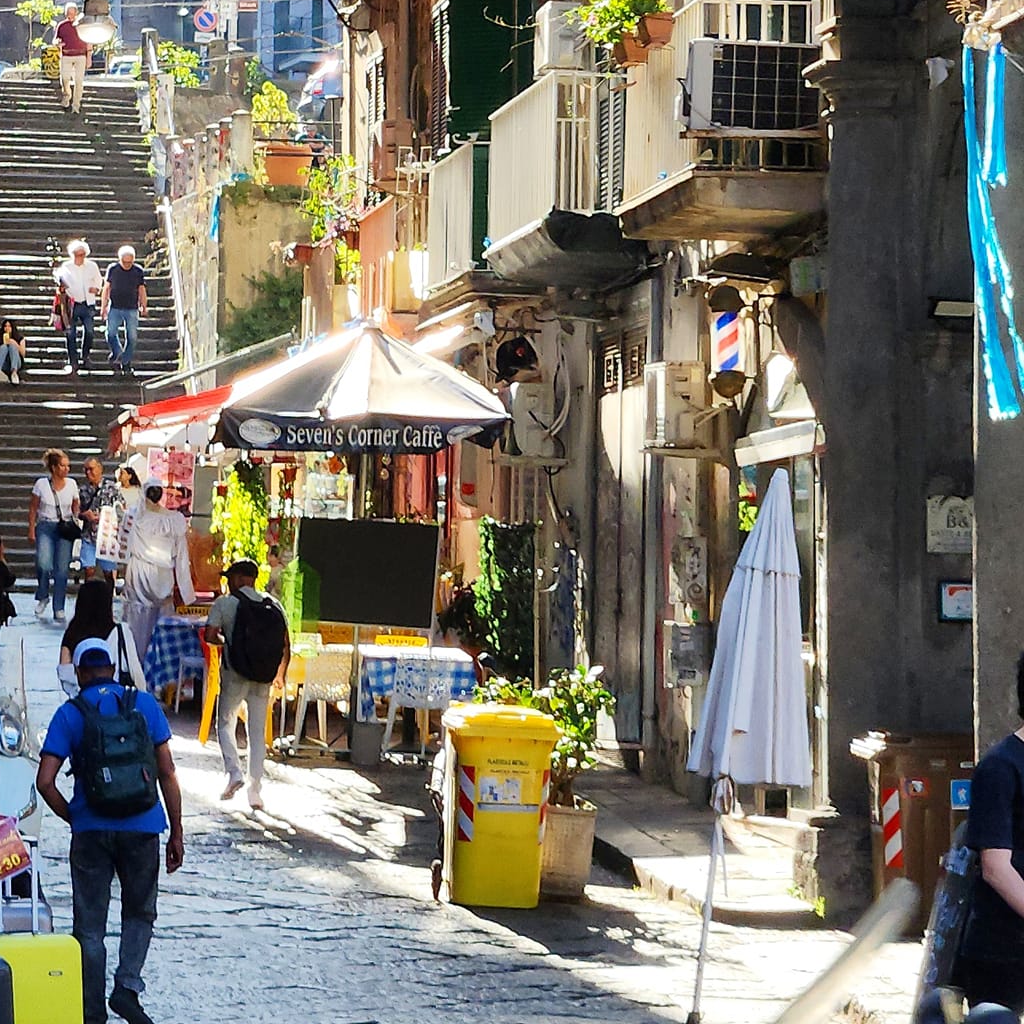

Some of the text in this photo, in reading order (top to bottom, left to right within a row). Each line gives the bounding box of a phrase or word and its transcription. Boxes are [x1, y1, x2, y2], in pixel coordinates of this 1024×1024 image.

[287, 424, 343, 446] Seven's
[348, 424, 399, 447] Corner
[403, 424, 443, 449] Caffè
